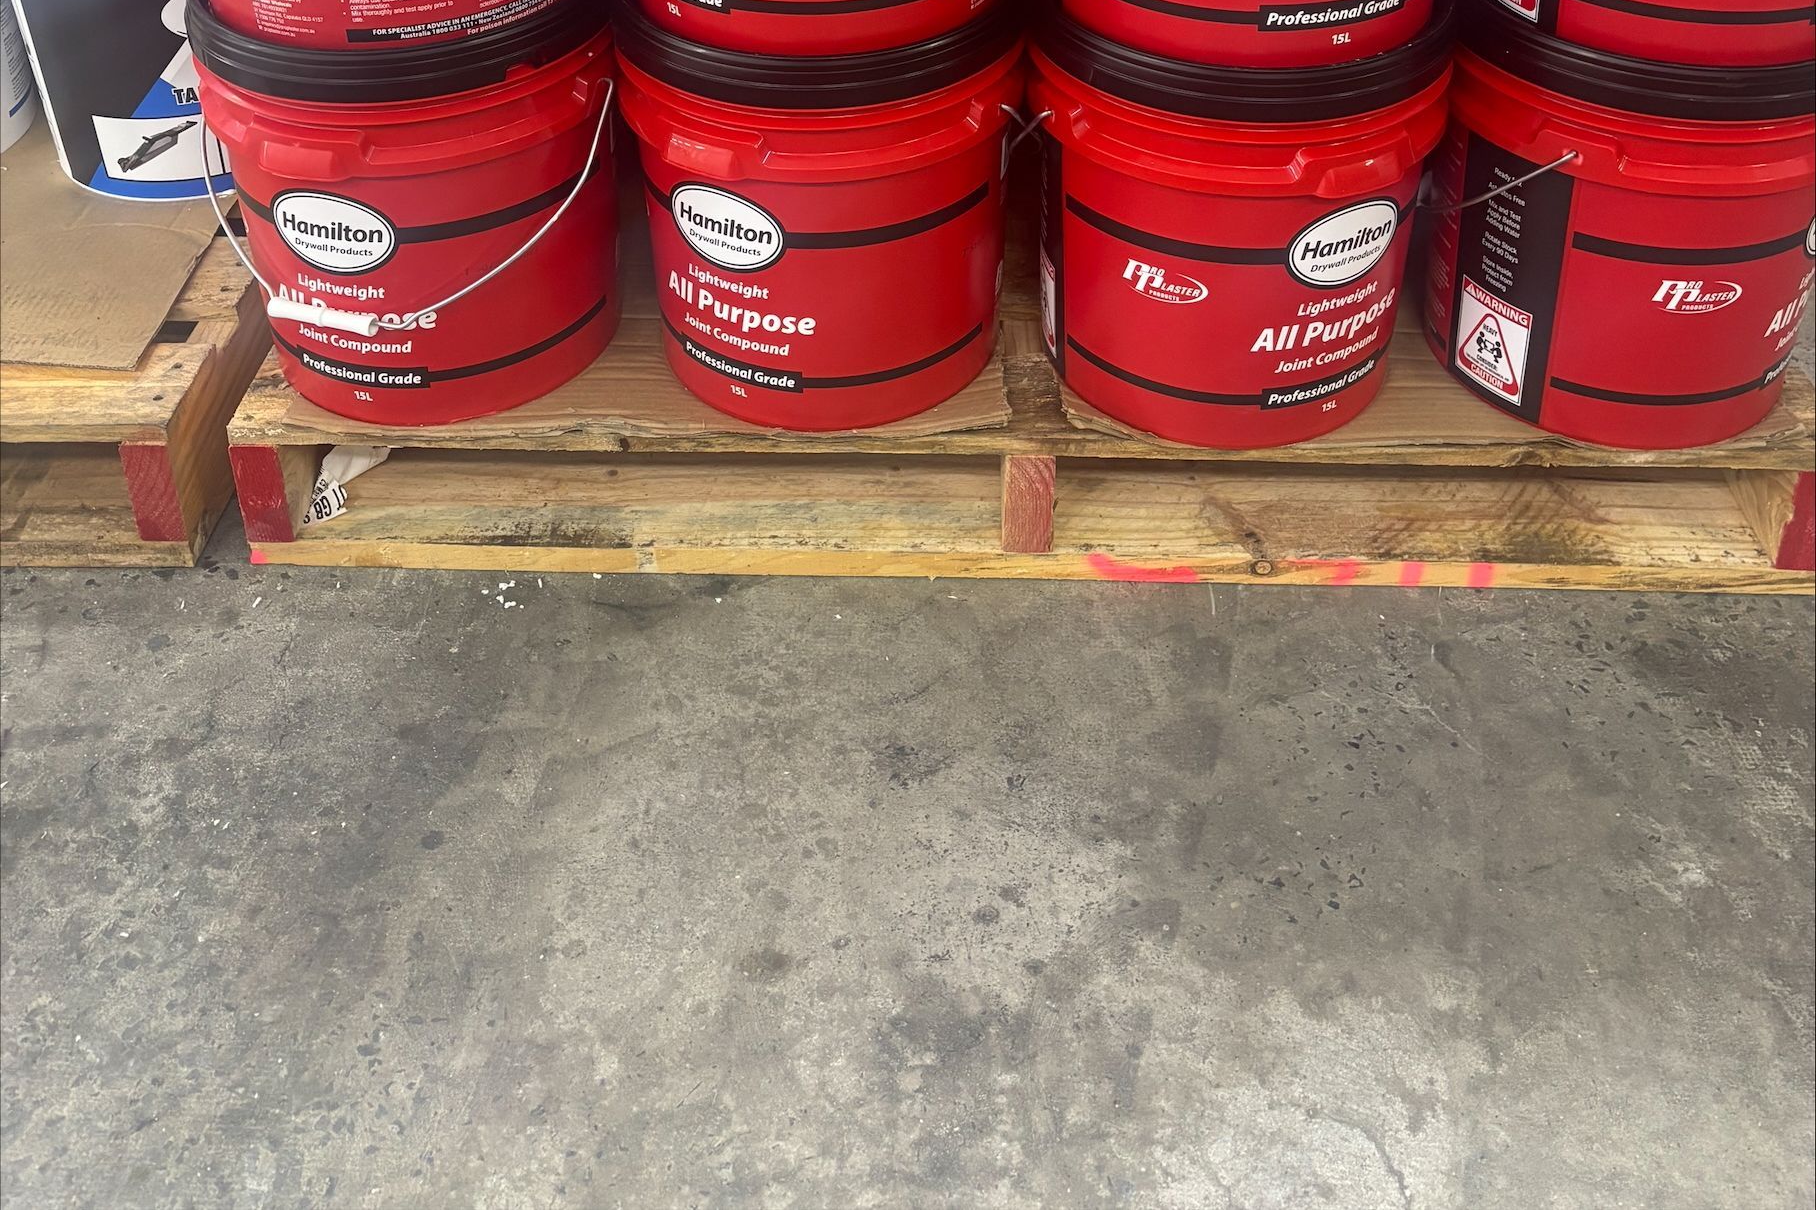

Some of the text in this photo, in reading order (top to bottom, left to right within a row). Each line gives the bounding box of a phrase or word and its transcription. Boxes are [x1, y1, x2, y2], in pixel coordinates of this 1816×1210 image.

[666, 1, 682, 18] 15L
[1265, 4, 1362, 26] Professional
[388, 24, 426, 34] SPECIALIST
[427, 20, 451, 29] ADVICE
[400, 29, 431, 39] Australia
[1331, 32, 1352, 46] 15L
[281, 210, 384, 244] Hamilton
[679, 200, 773, 246] Hamilton
[294, 237, 374, 258] Drywall Products
[689, 227, 762, 258] Drywall Products
[1300, 218, 1393, 262] Hamilton
[1122, 258, 1166, 280] PRO
[1310, 244, 1381, 274] Drywall Products
[297, 273, 385, 301] Lightweight
[688, 262, 770, 300] Lightweight
[1134, 273, 1201, 298] PLASTER
[1651, 280, 1703, 303] PRO
[668, 269, 817, 338] All Purpose
[1148, 290, 1181, 302] PRODUCTS
[1297, 281, 1378, 318] Lightweight
[1476, 288, 1528, 325] WARNING
[1668, 290, 1736, 311] PLASTER
[1681, 303, 1714, 311] PRODUCTS
[1250, 288, 1396, 353] All Purpose
[1764, 297, 1799, 337] All
[299, 324, 412, 354] Joint Compound
[684, 311, 790, 358] Joint Compound
[685, 341, 796, 389] Professional Grade
[1274, 327, 1379, 374] Joint Compound
[303, 354, 421, 385] Professional Grade
[1268, 359, 1375, 406] Professional Grade
[1470, 363, 1504, 389] CAUTION
[354, 391, 373, 401] 15L
[730, 384, 748, 399] 15L
[1321, 400, 1338, 413] 15L
